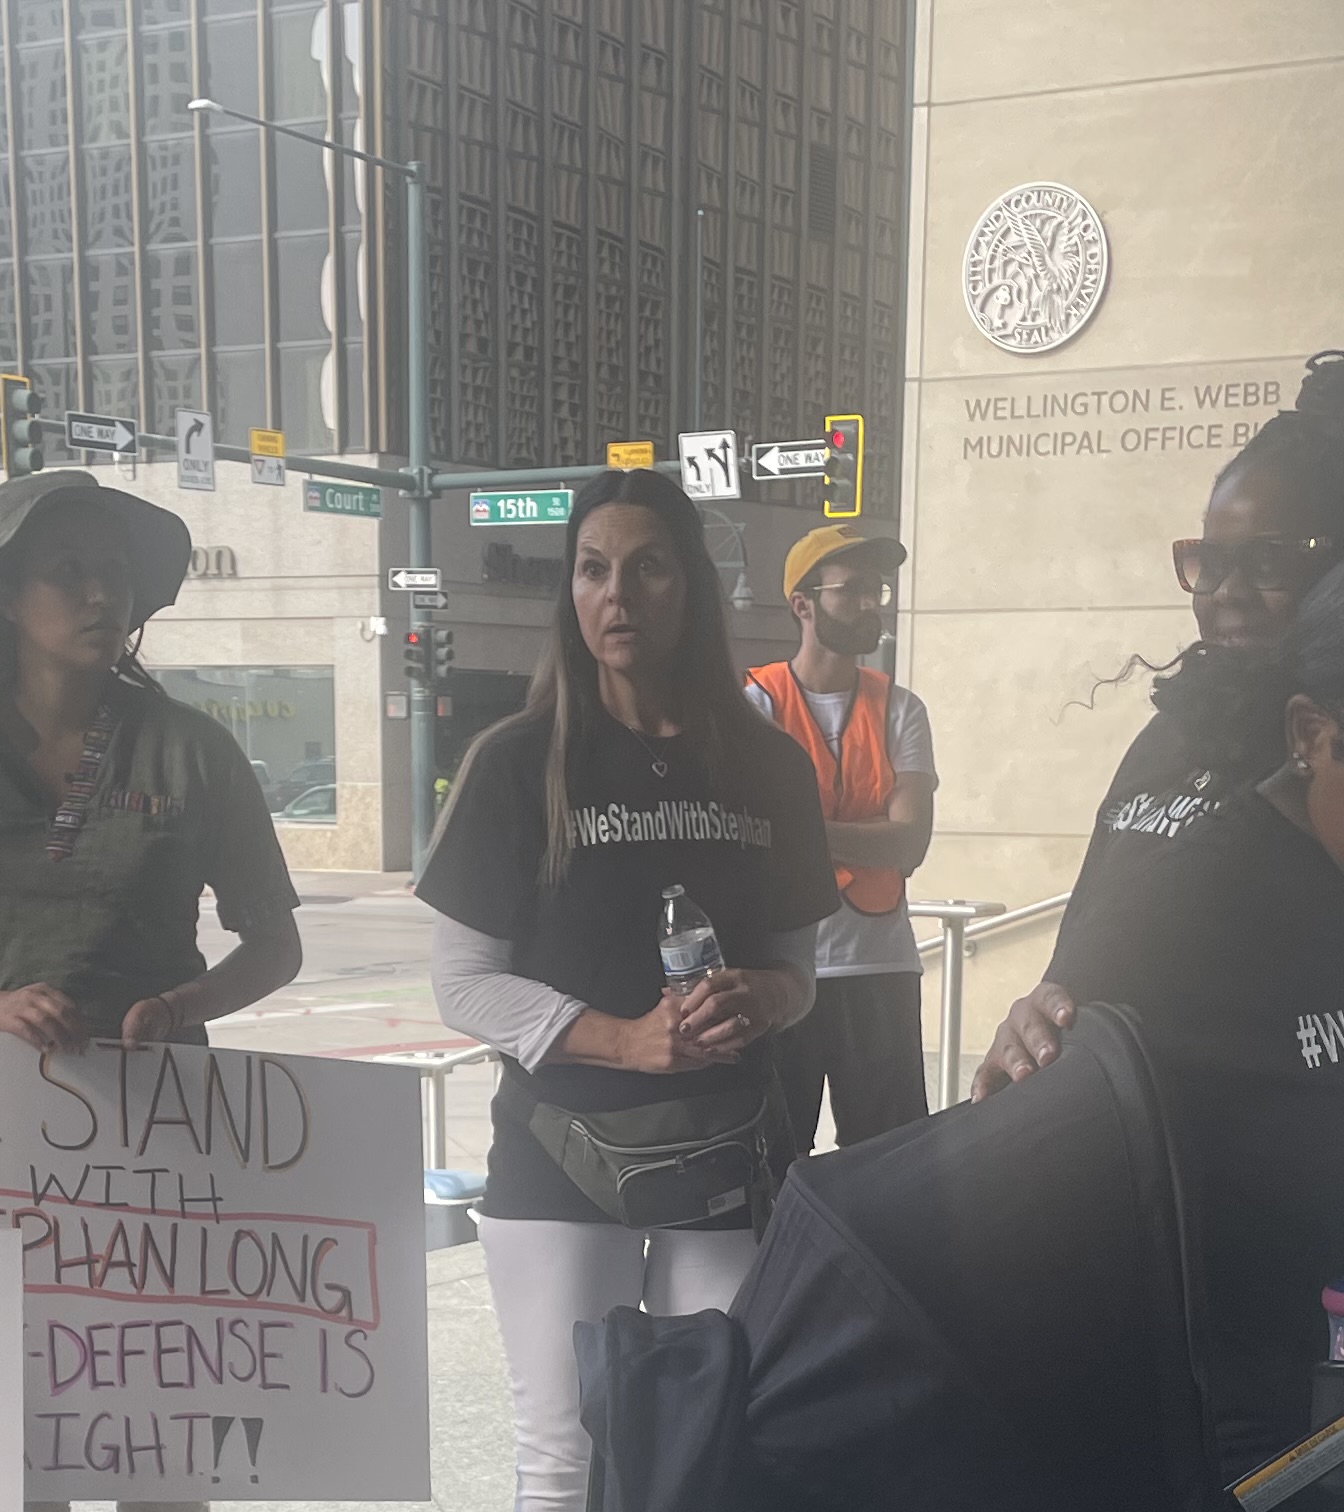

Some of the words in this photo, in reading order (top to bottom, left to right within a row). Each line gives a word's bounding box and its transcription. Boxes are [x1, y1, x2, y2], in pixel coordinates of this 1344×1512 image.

[969, 250, 983, 295] CITY
[977, 210, 1004, 248] AND
[1010, 189, 1074, 212] COUNTY
[1066, 251, 1100, 319] DENVER
[964, 387, 1151, 422] WELLINGTON
[1160, 386, 1184, 412] E.
[1194, 380, 1281, 410] WEBB
[74, 423, 95, 439] ONE
[963, 429, 1112, 460] MUNICIPAL
[1120, 423, 1223, 452] OFFICE
[183, 458, 210, 473] ONLY
[778, 454, 801, 467] ONE
[325, 488, 365, 511] Court
[497, 496, 538, 519] 15th
[39, 1036, 311, 1170] STAND
[29, 1164, 225, 1224] WITH
[201, 1228, 355, 1322] LONG
[319, 1327, 376, 1399] IS
